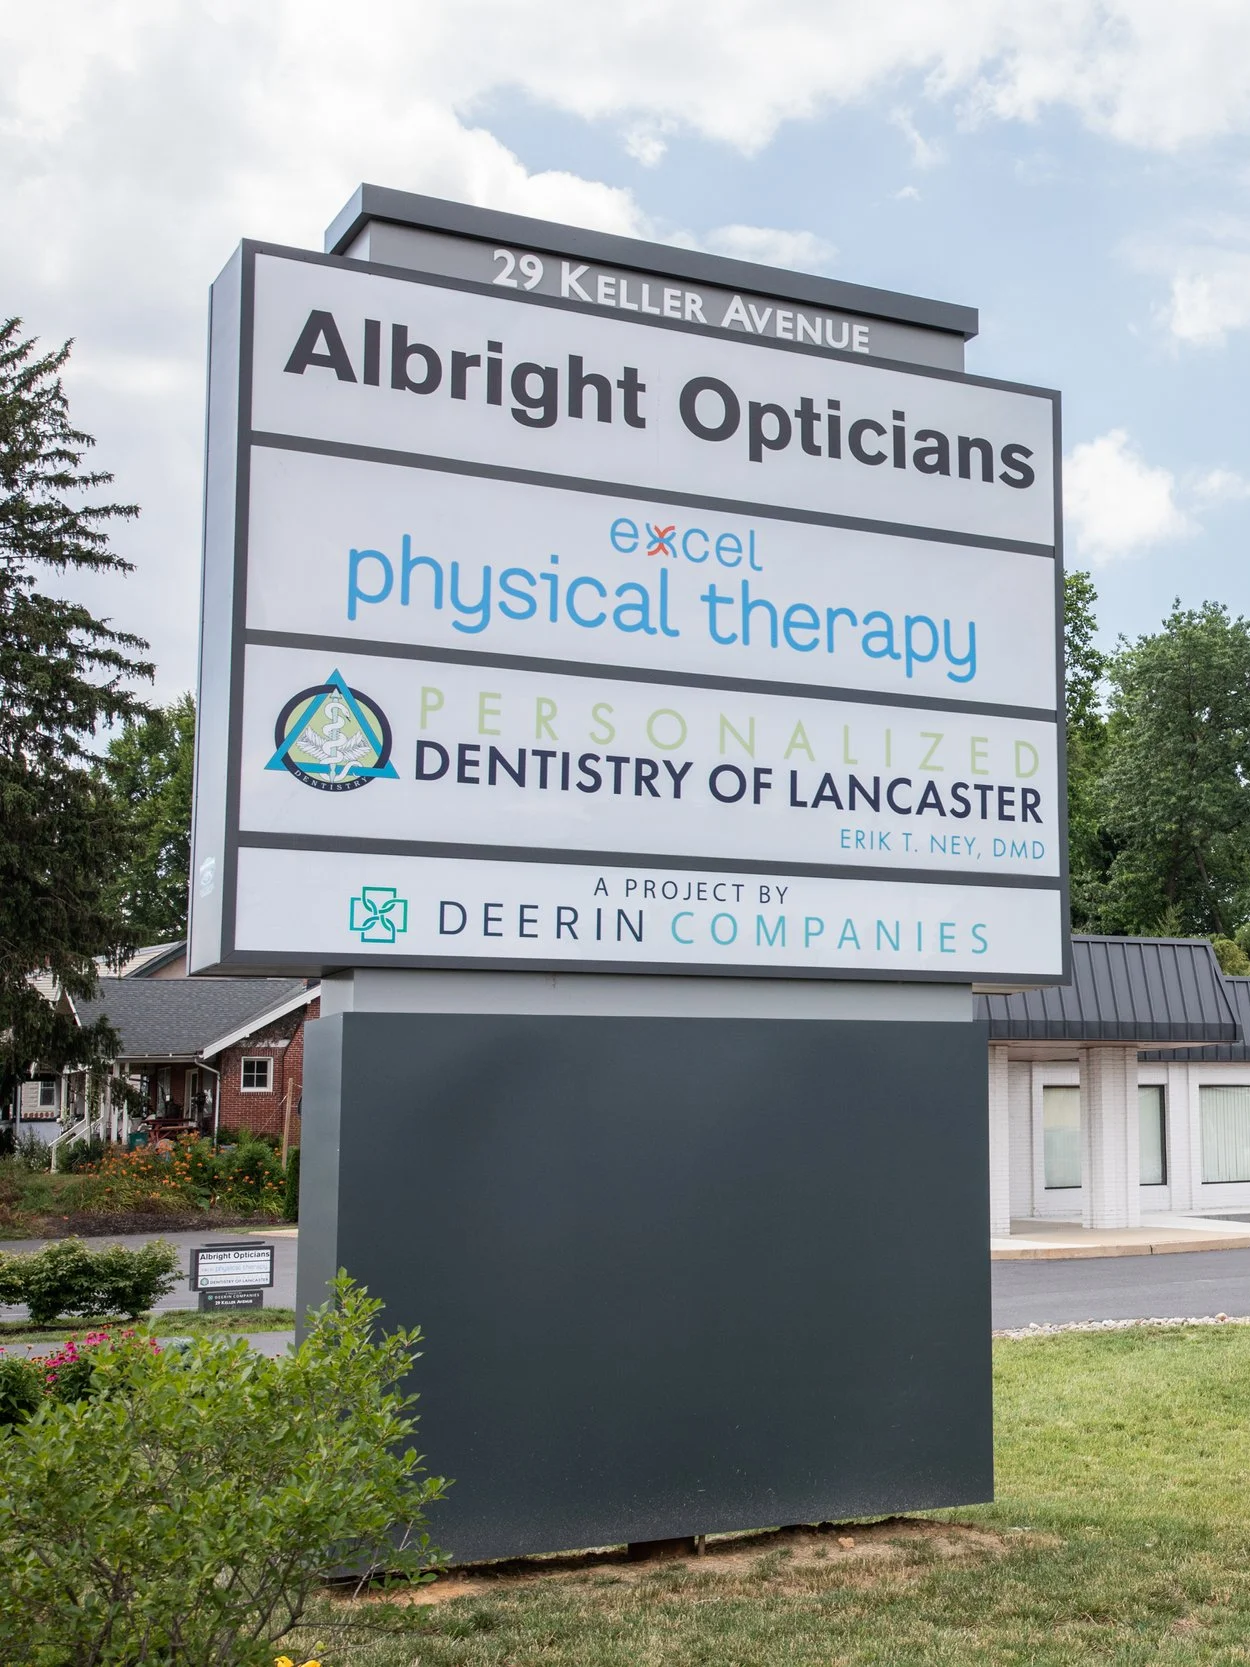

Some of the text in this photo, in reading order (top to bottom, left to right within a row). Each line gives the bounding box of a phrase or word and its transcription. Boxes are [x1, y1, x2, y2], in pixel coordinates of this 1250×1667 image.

[493, 249, 870, 354] 29 KELLER AVENUE
[284, 309, 1036, 490] Albright Opticians
[610, 518, 763, 572] excel
[347, 534, 978, 684] physical therapy
[419, 686, 1041, 779] PERSONALIZED
[294, 769, 368, 791] DENTISTRY
[415, 741, 1044, 825] DENTISTRY OF LANCASTER
[841, 829, 1045, 860] ERIK T. NEY, DMD
[594, 877, 789, 905] A PROJECT BY
[439, 901, 989, 955] DEERIN COMPANIES
[200, 1251, 270, 1261] Albright Opticians
